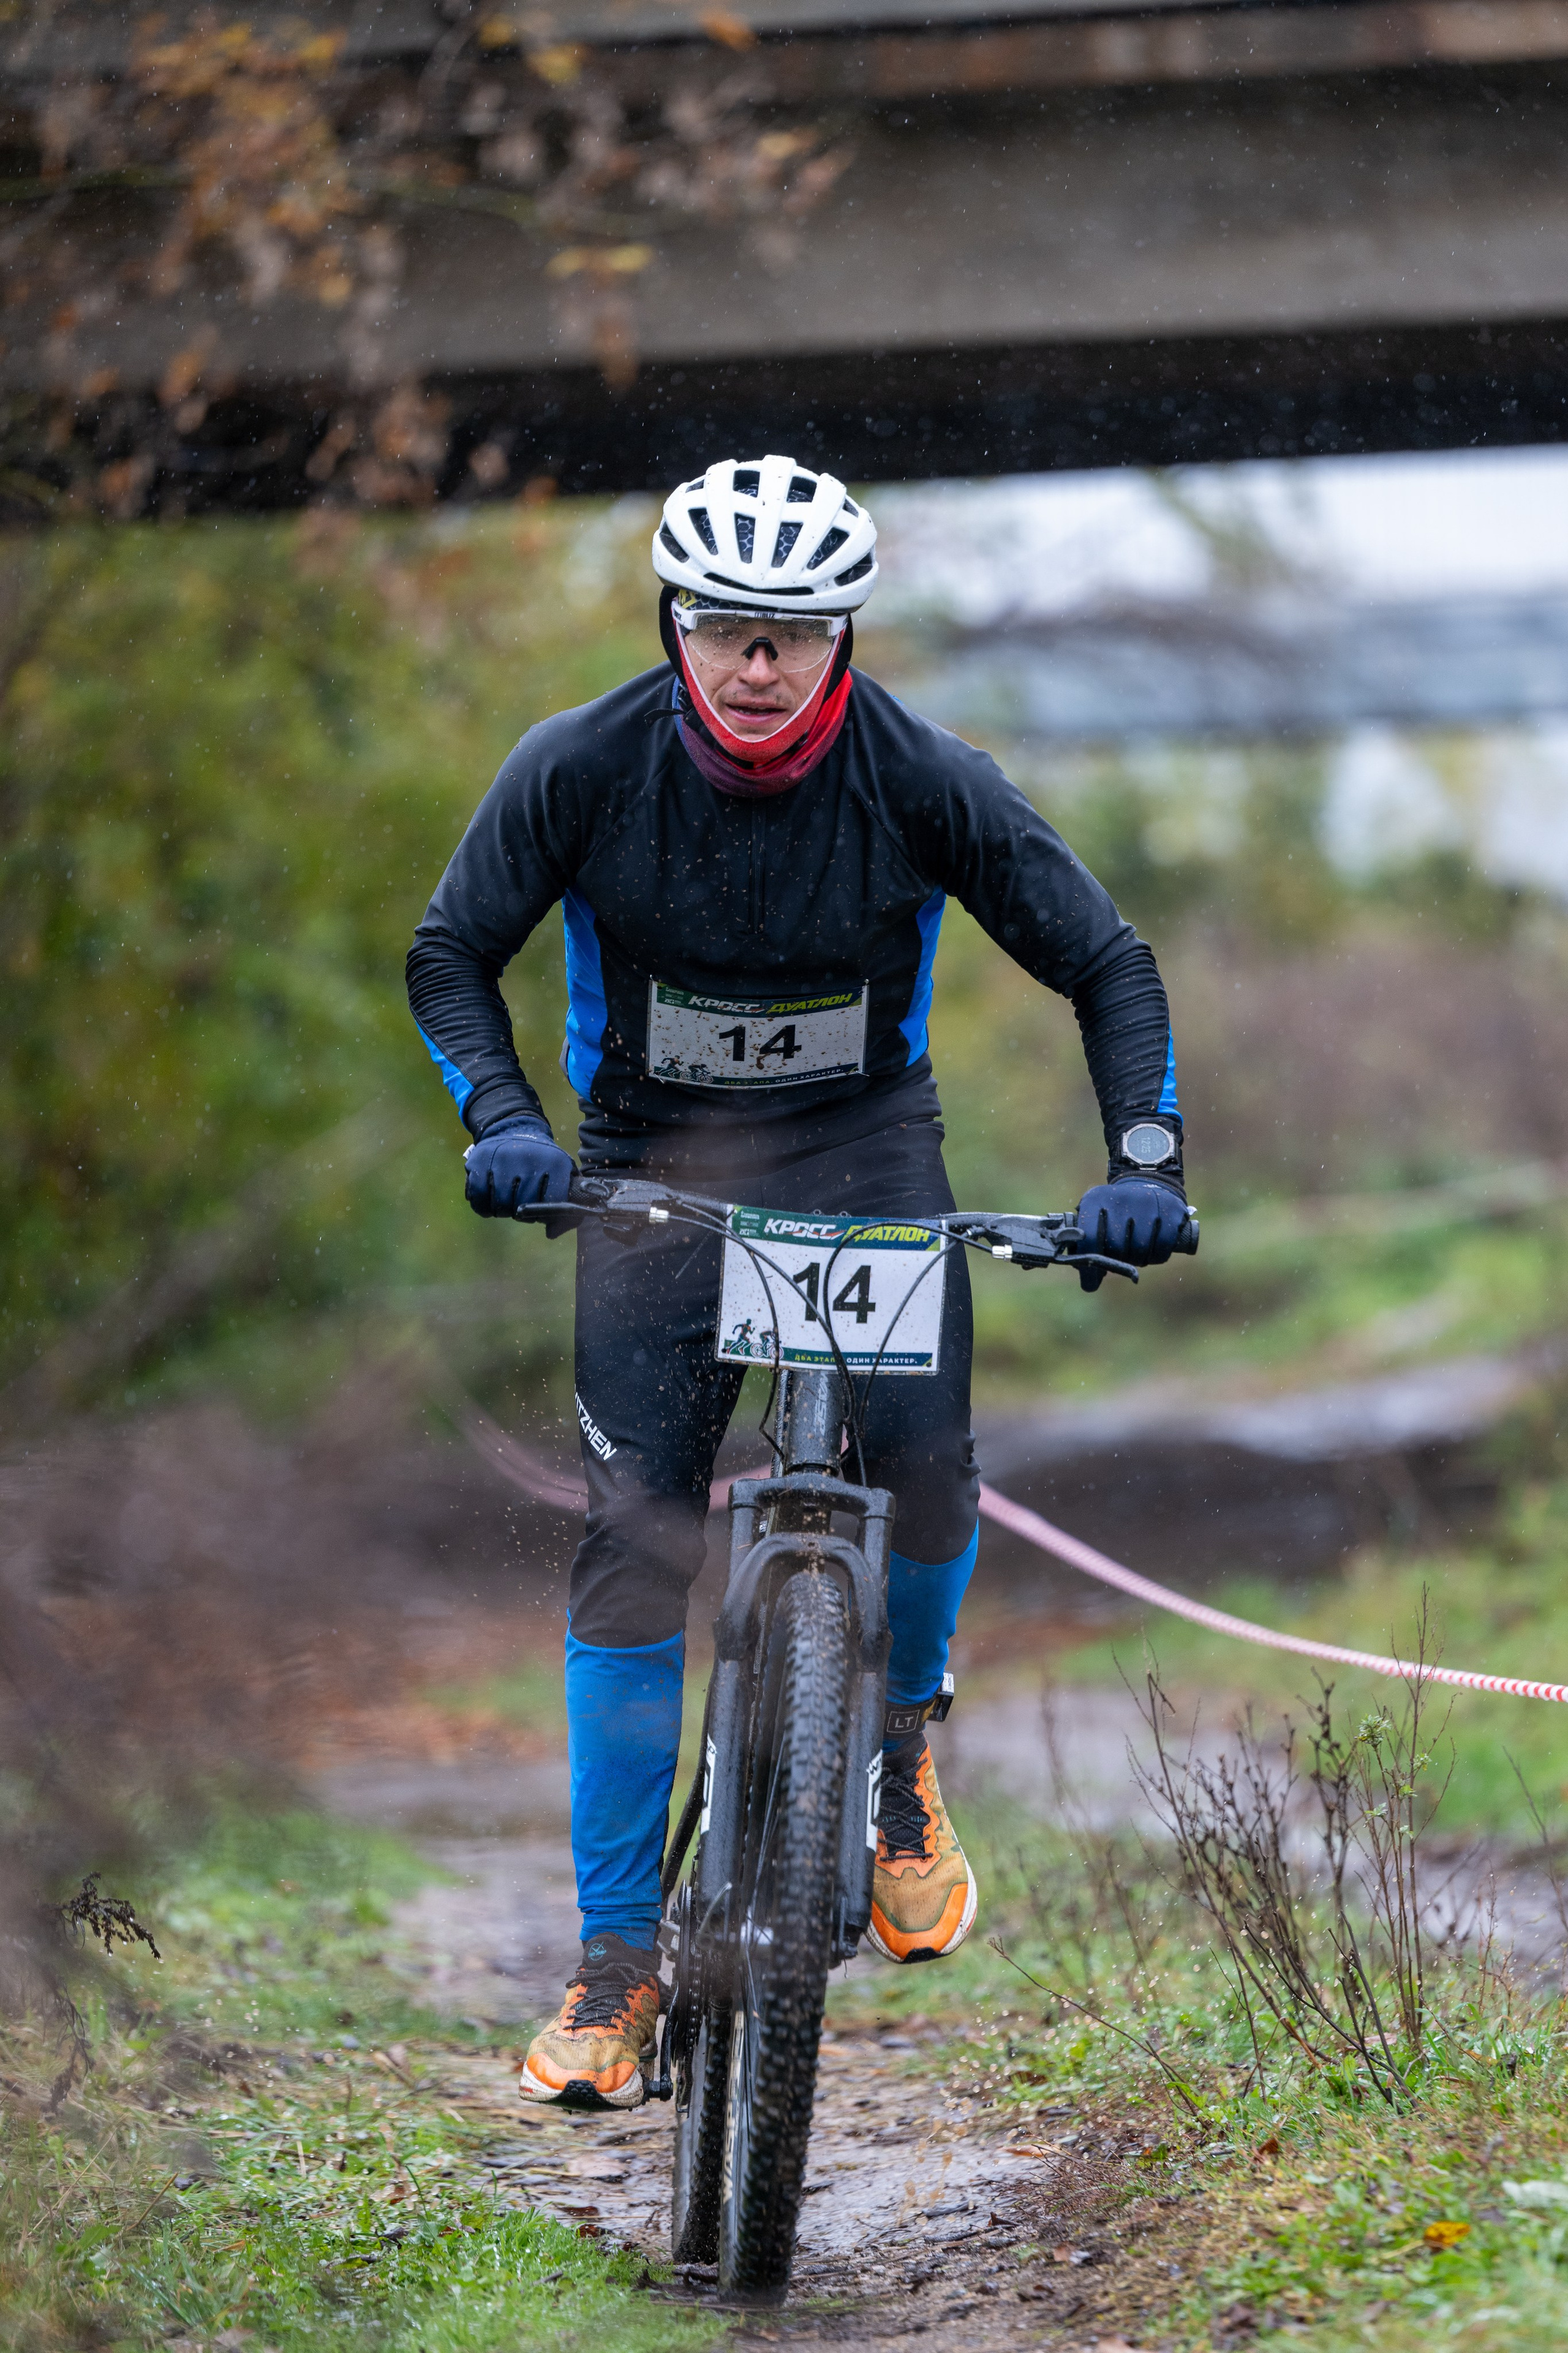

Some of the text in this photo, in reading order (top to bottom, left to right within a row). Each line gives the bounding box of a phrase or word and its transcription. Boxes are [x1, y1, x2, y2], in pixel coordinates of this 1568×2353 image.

[688, 992, 853, 1014] КРОСС ДУАТЛОН
[719, 1024, 802, 1062] 14
[799, 1068, 844, 1079] ХАРАКТЕР.
[764, 1218, 846, 1241] КРОСС
[793, 1262, 876, 1324] 14
[895, 1717, 914, 1728] LT
